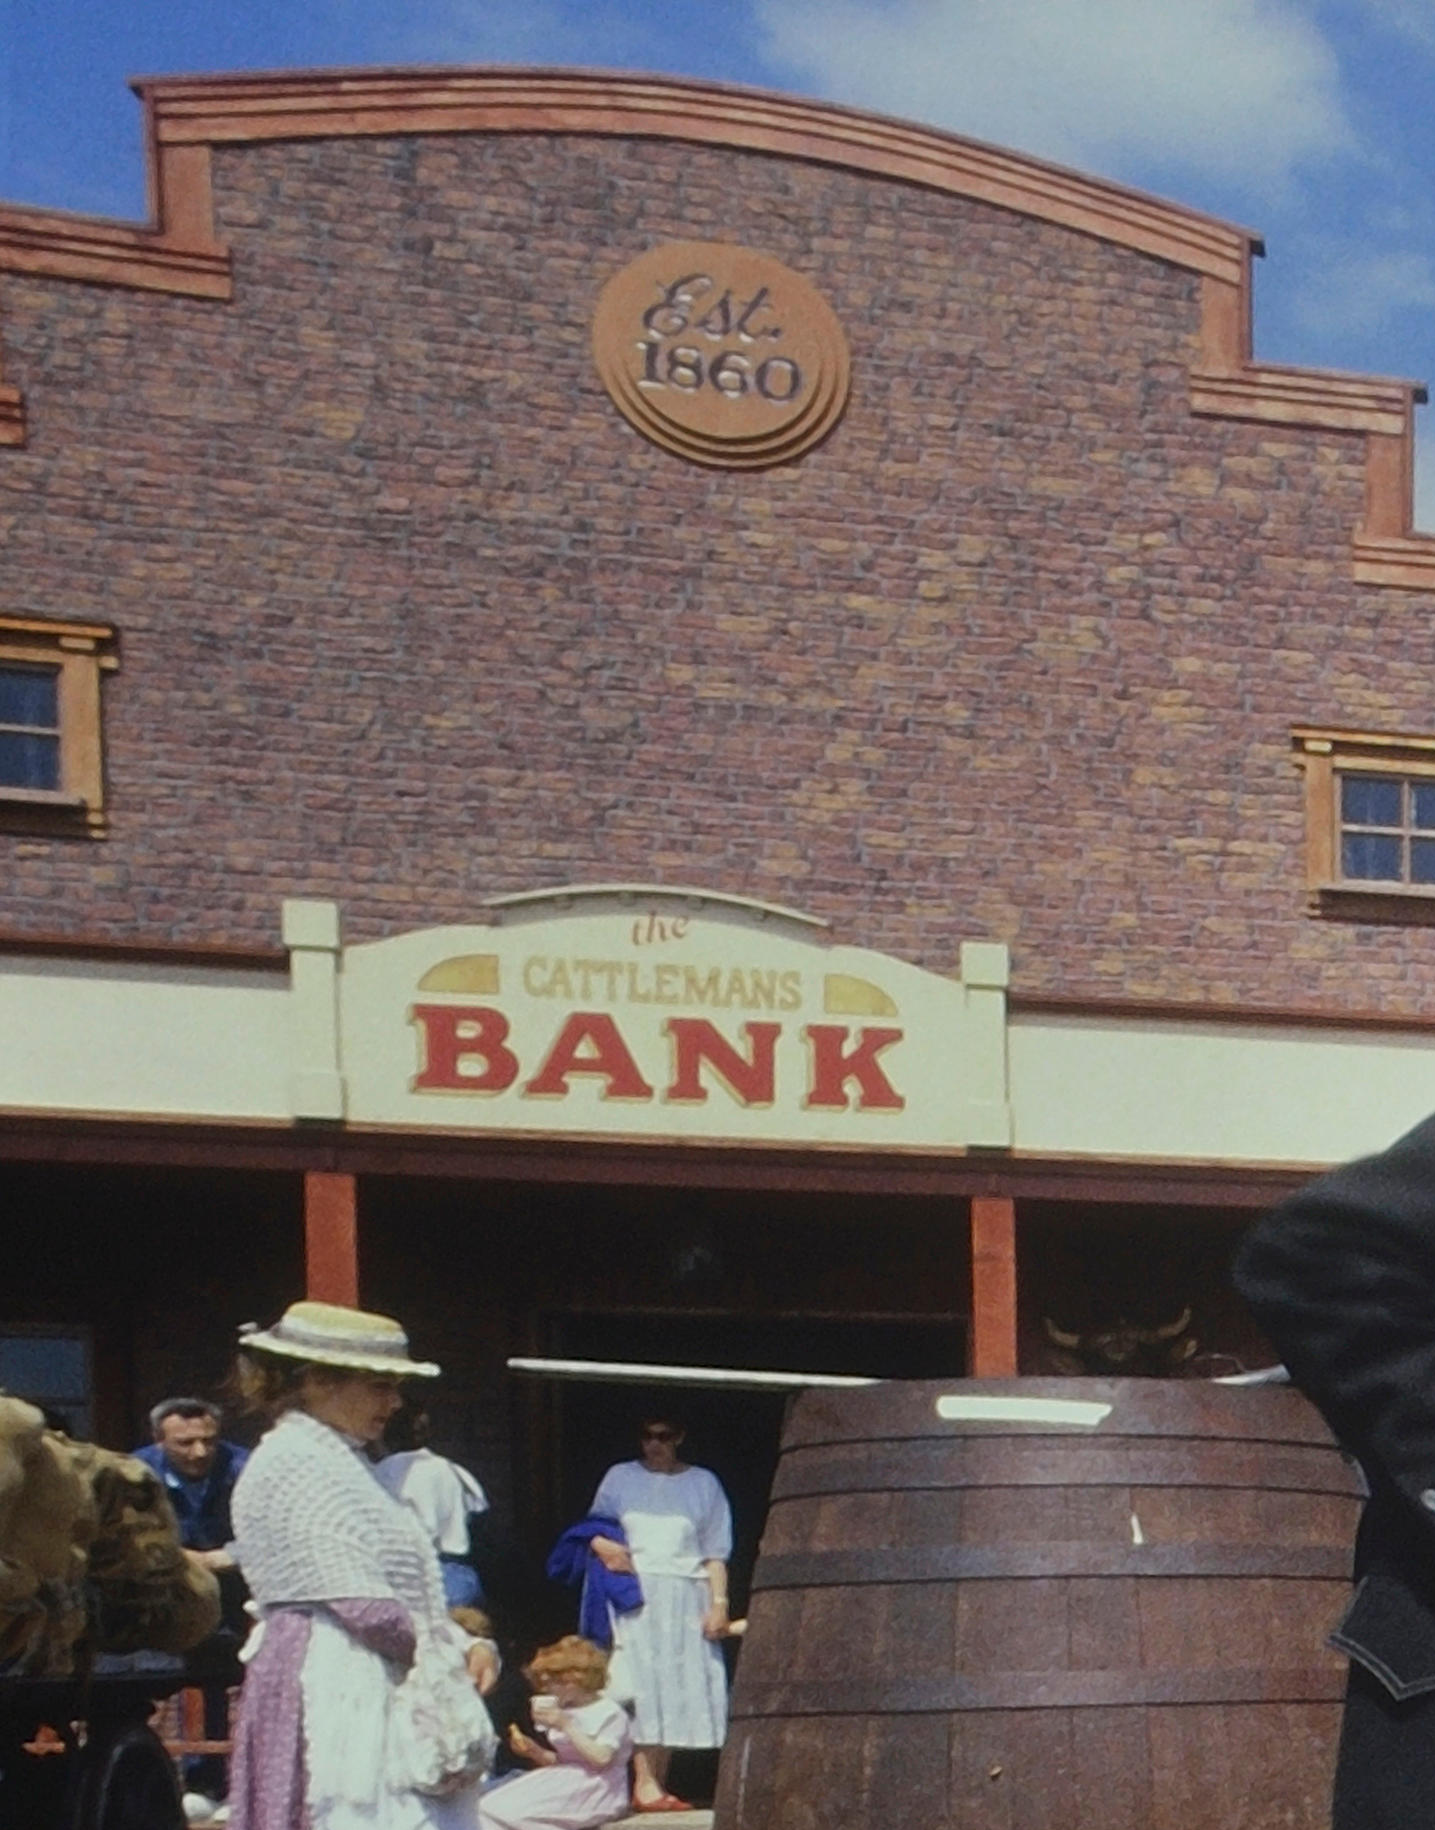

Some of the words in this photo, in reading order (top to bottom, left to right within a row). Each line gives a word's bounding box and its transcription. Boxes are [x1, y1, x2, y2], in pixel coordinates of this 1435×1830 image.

[642, 272, 783, 343] Est.
[636, 341, 803, 404] 1860
[631, 909, 691, 947] the
[521, 954, 804, 1011] CATTLEMANS
[408, 1002, 907, 1114] BANK
